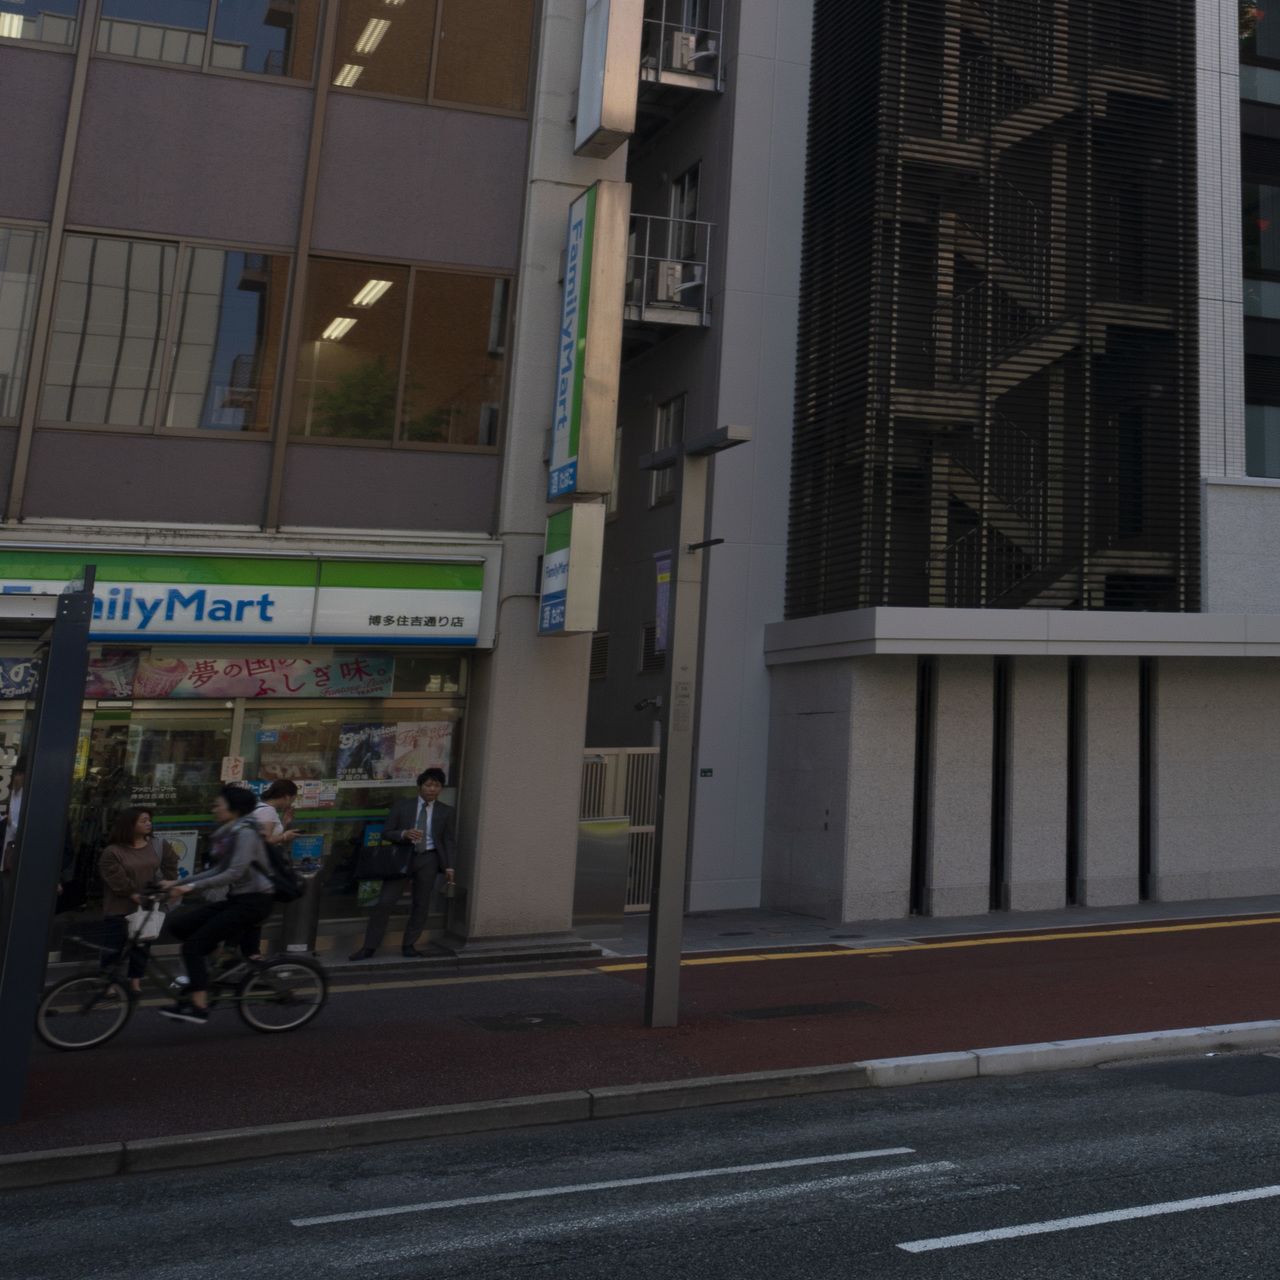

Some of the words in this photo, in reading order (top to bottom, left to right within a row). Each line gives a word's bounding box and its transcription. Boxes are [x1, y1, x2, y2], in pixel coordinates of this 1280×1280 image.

[555, 217, 584, 432] FamilyMart
[367, 615, 464, 628] 博多住吉通り店
